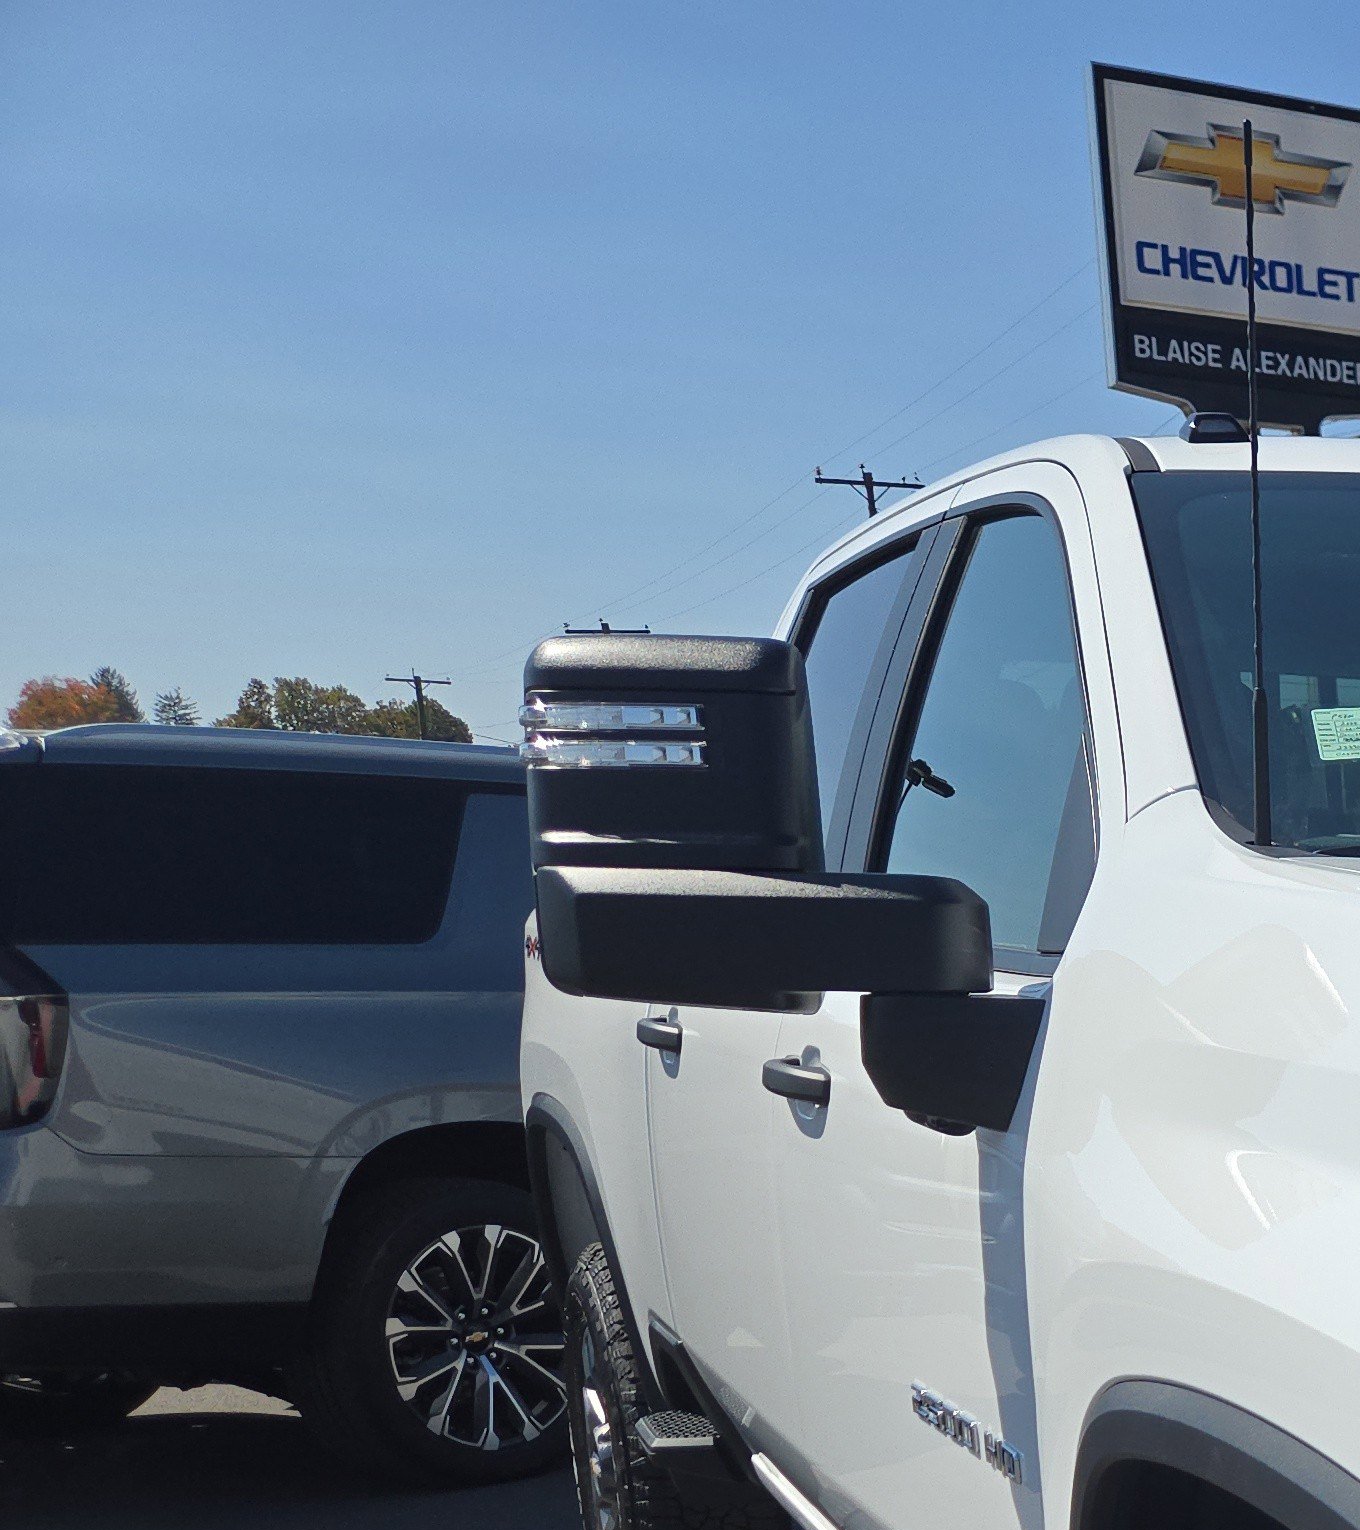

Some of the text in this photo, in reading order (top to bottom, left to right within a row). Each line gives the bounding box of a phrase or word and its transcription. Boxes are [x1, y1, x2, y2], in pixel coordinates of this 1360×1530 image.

[1134, 240, 1360, 303] CHEVROLET
[1133, 333, 1223, 369] BLAISE
[983, 1429, 1024, 1485] HD
